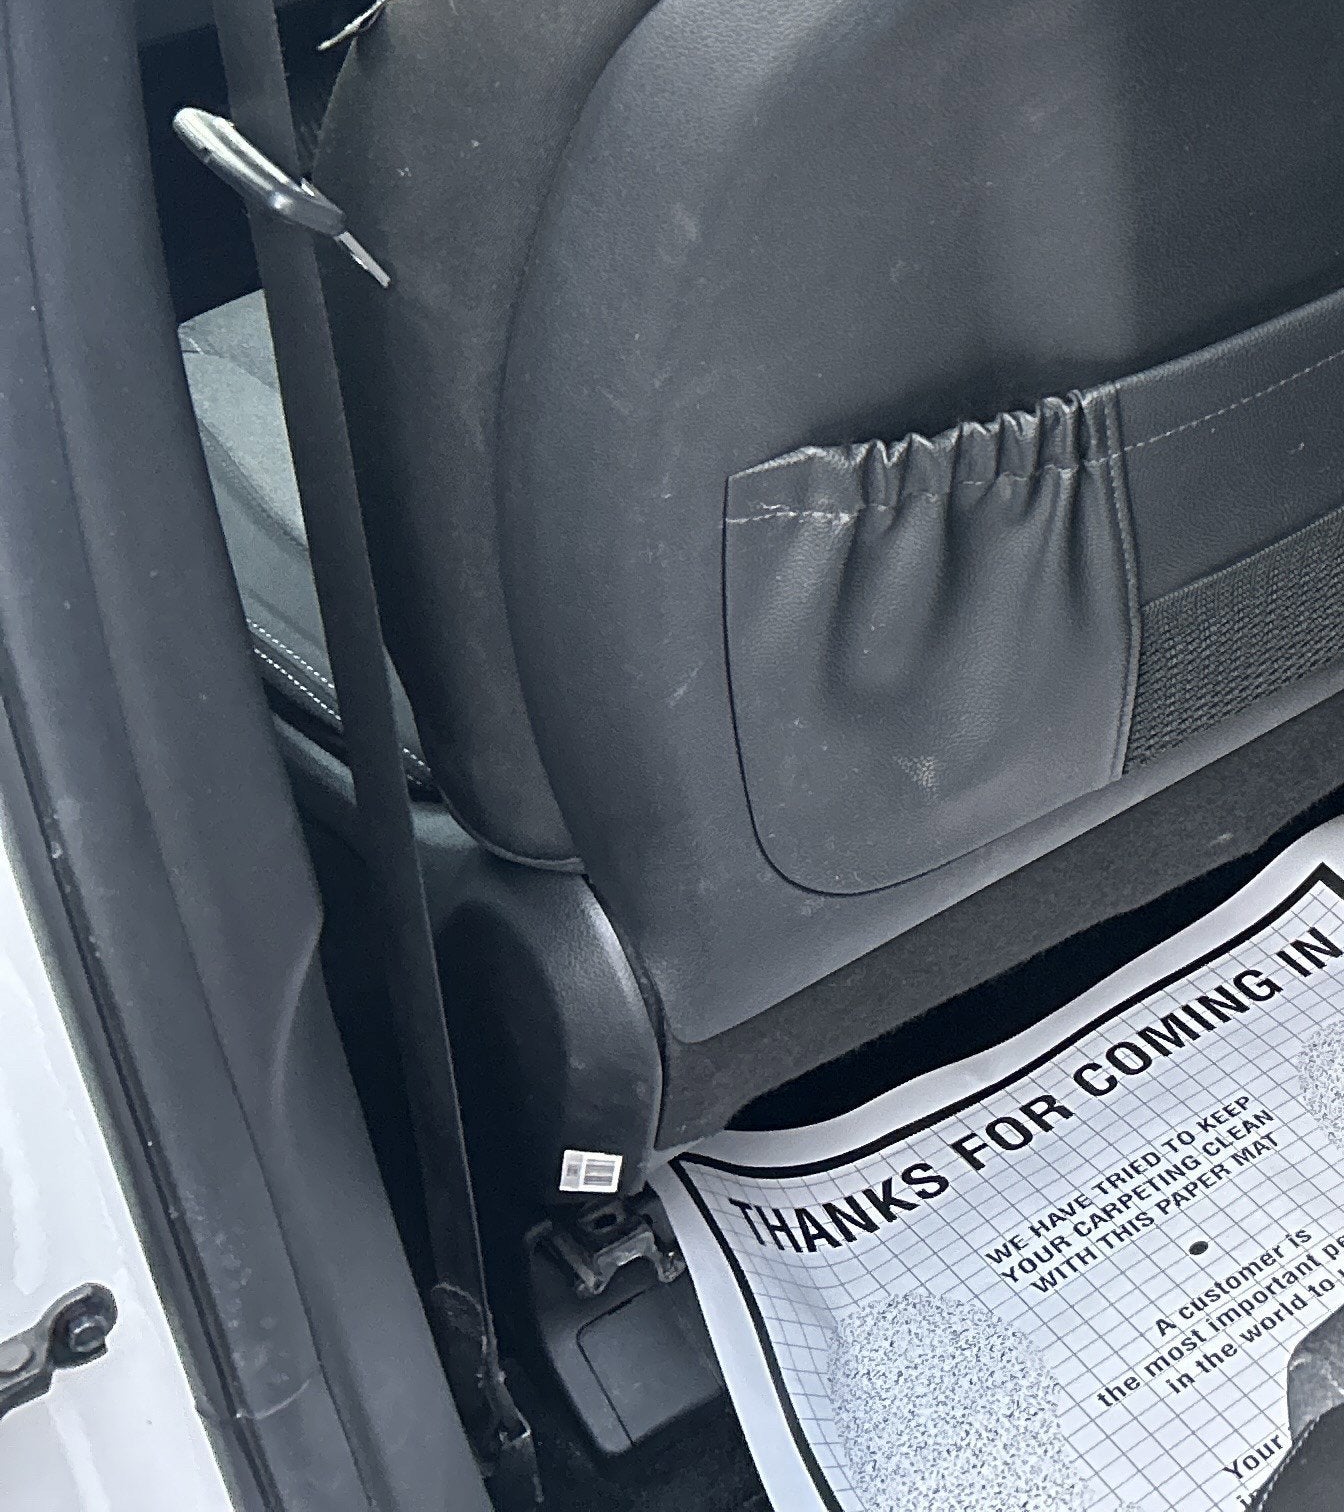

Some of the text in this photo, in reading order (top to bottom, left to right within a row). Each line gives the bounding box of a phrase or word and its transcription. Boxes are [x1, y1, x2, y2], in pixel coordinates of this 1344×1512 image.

[728, 927, 1344, 1255] THANKS FOR COMING IN
[985, 1095, 1251, 1265] WE HAVE TRIED TO KEEP
[1000, 1109, 1275, 1284] YOUR CARPETING CLEAN
[1030, 1131, 1281, 1293] WITH THIS PAPER MAT
[1097, 1375, 1141, 1408] the
[1143, 1328, 1208, 1378] most
[1204, 1253, 1322, 1333] important
[1155, 1228, 1313, 1337] A customer is
[1164, 1372, 1196, 1395] in
[1195, 1341, 1239, 1375] the
[1238, 1293, 1309, 1343] world
[1308, 1275, 1336, 1299] to
[1221, 1433, 1284, 1480] Your
